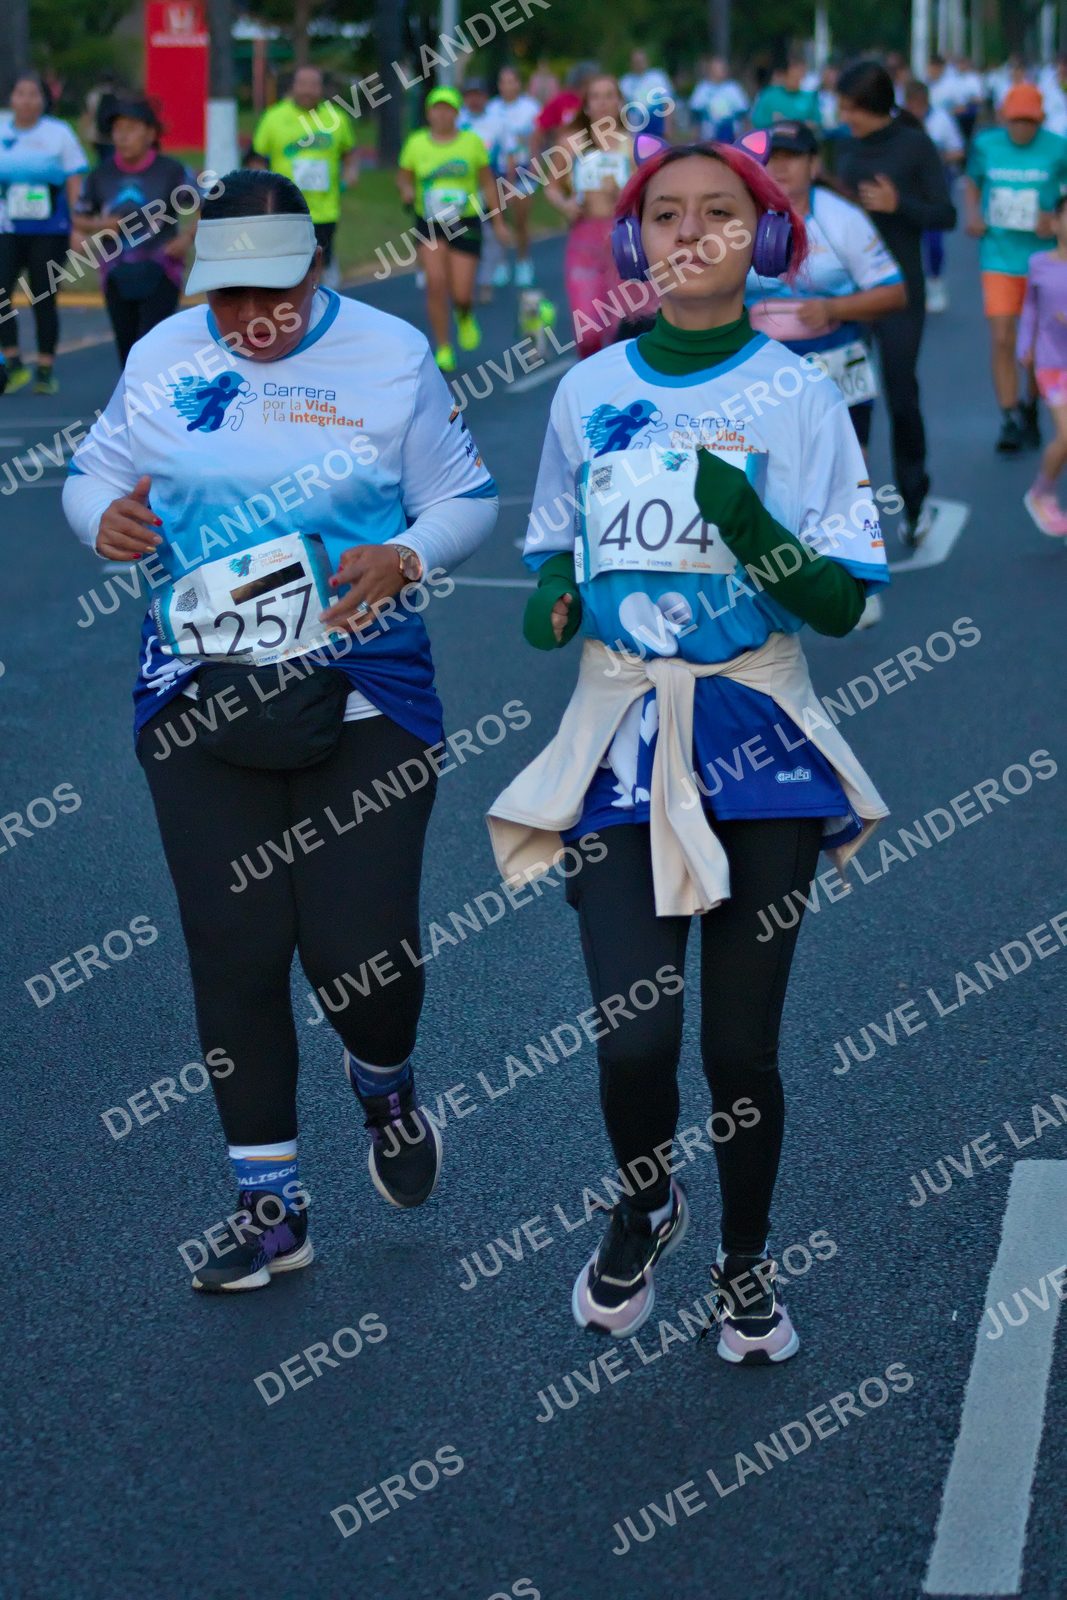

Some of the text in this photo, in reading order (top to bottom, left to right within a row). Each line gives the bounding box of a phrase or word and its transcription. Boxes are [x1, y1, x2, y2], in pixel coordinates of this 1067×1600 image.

[264, 383, 336, 400] Carrera
[263, 399, 336, 414] por la Vida
[263, 410, 363, 427] y la Integridad
[675, 413, 745, 431] Carrera
[716, 429, 745, 443] Vida
[598, 499, 713, 554] 404
[182, 583, 313, 657] 1257
